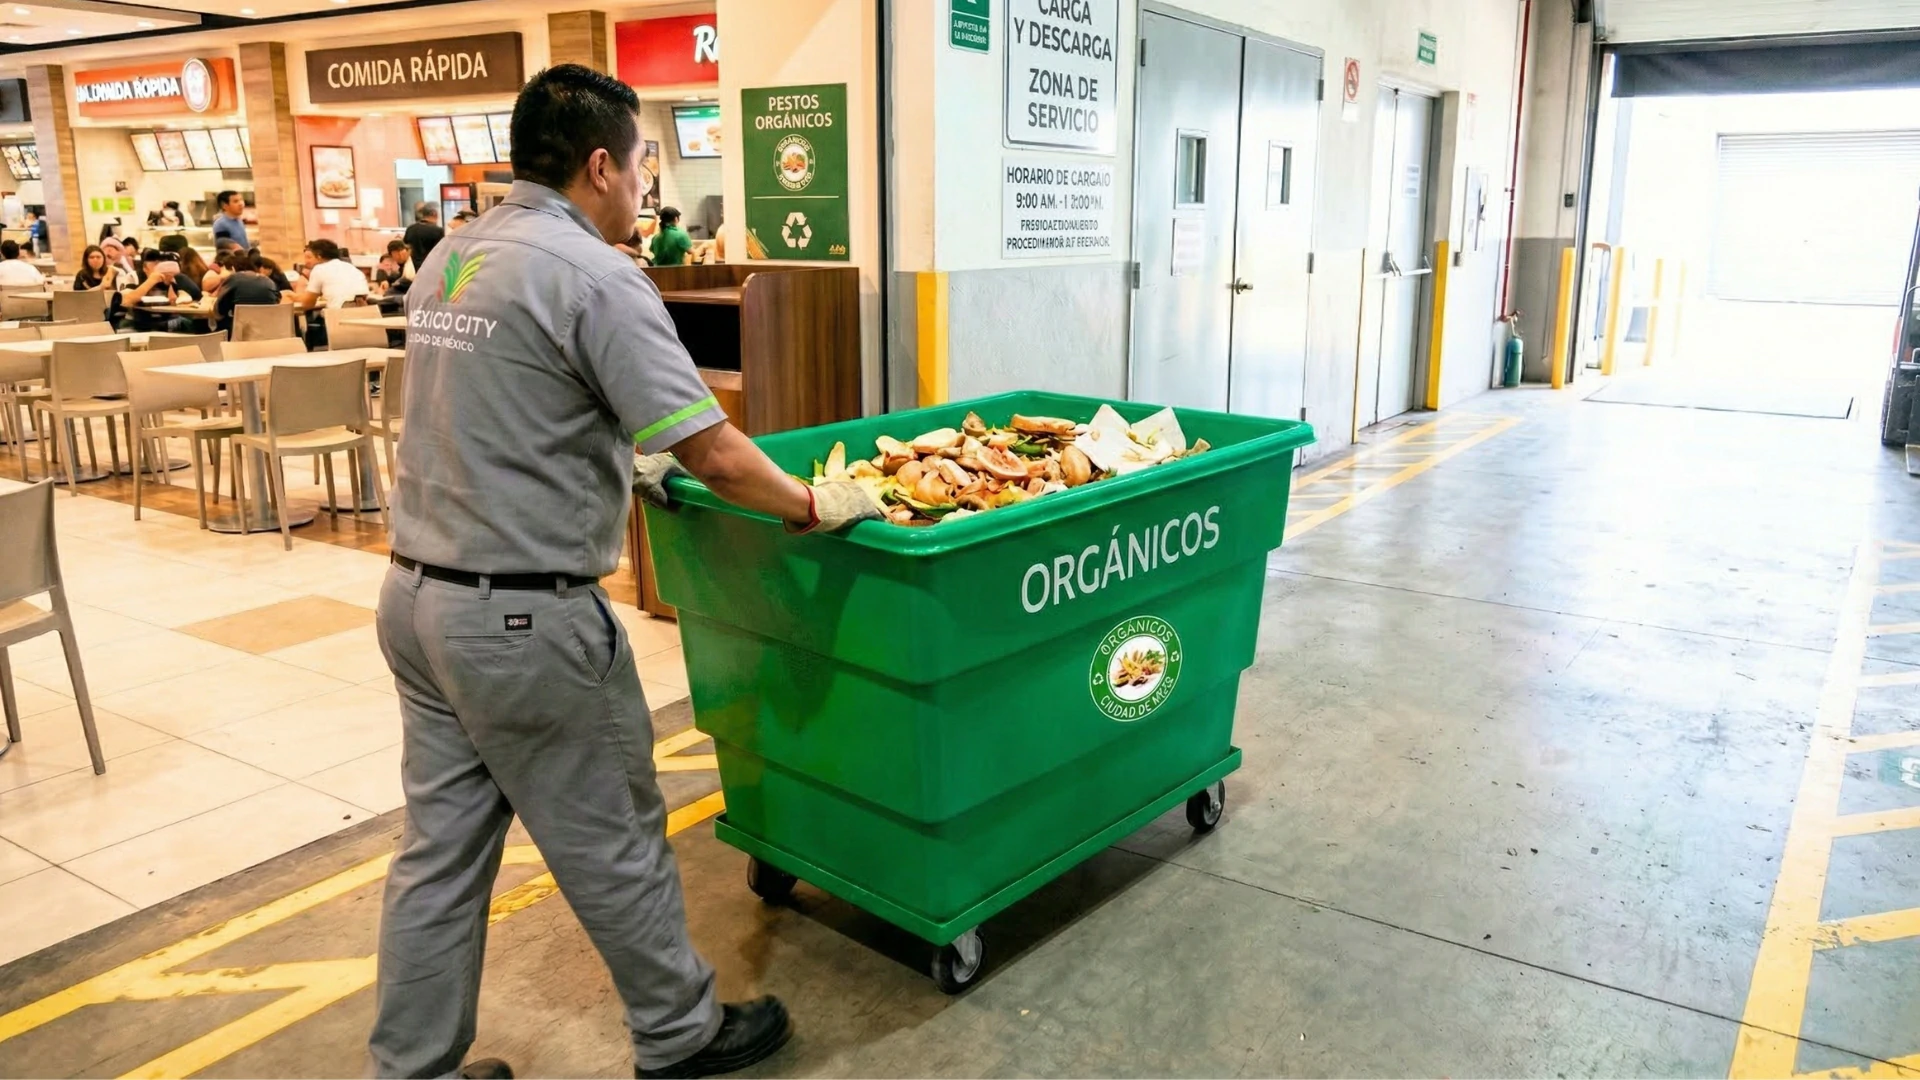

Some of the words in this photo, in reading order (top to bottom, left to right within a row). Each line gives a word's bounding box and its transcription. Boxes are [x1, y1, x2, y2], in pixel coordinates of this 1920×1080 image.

[1038, 0, 1092, 26] CARGA
[693, 24, 719, 63] R
[1013, 17, 1025, 44] Y
[1029, 21, 1112, 61] DESCARGA
[327, 58, 406, 88] COMIDA
[410, 48, 488, 83] RÁPIDA
[1029, 68, 1074, 99] ZONA
[1078, 76, 1098, 102] DE
[768, 94, 820, 111] PESTOS
[755, 112, 833, 130] ORGÁNICOS
[1028, 101, 1099, 134] SERVICIO
[1007, 166, 1054, 185] HORARIO
[1056, 169, 1069, 186] DE
[1016, 192, 1038, 209] 9:00
[455, 314, 498, 339] CITY
[1021, 505, 1221, 614] ORGÁNICOS
[1101, 619, 1173, 655] ORGÁNICOS
[1101, 694, 1136, 719] CIUDAD
[1139, 703, 1152, 716] DE
